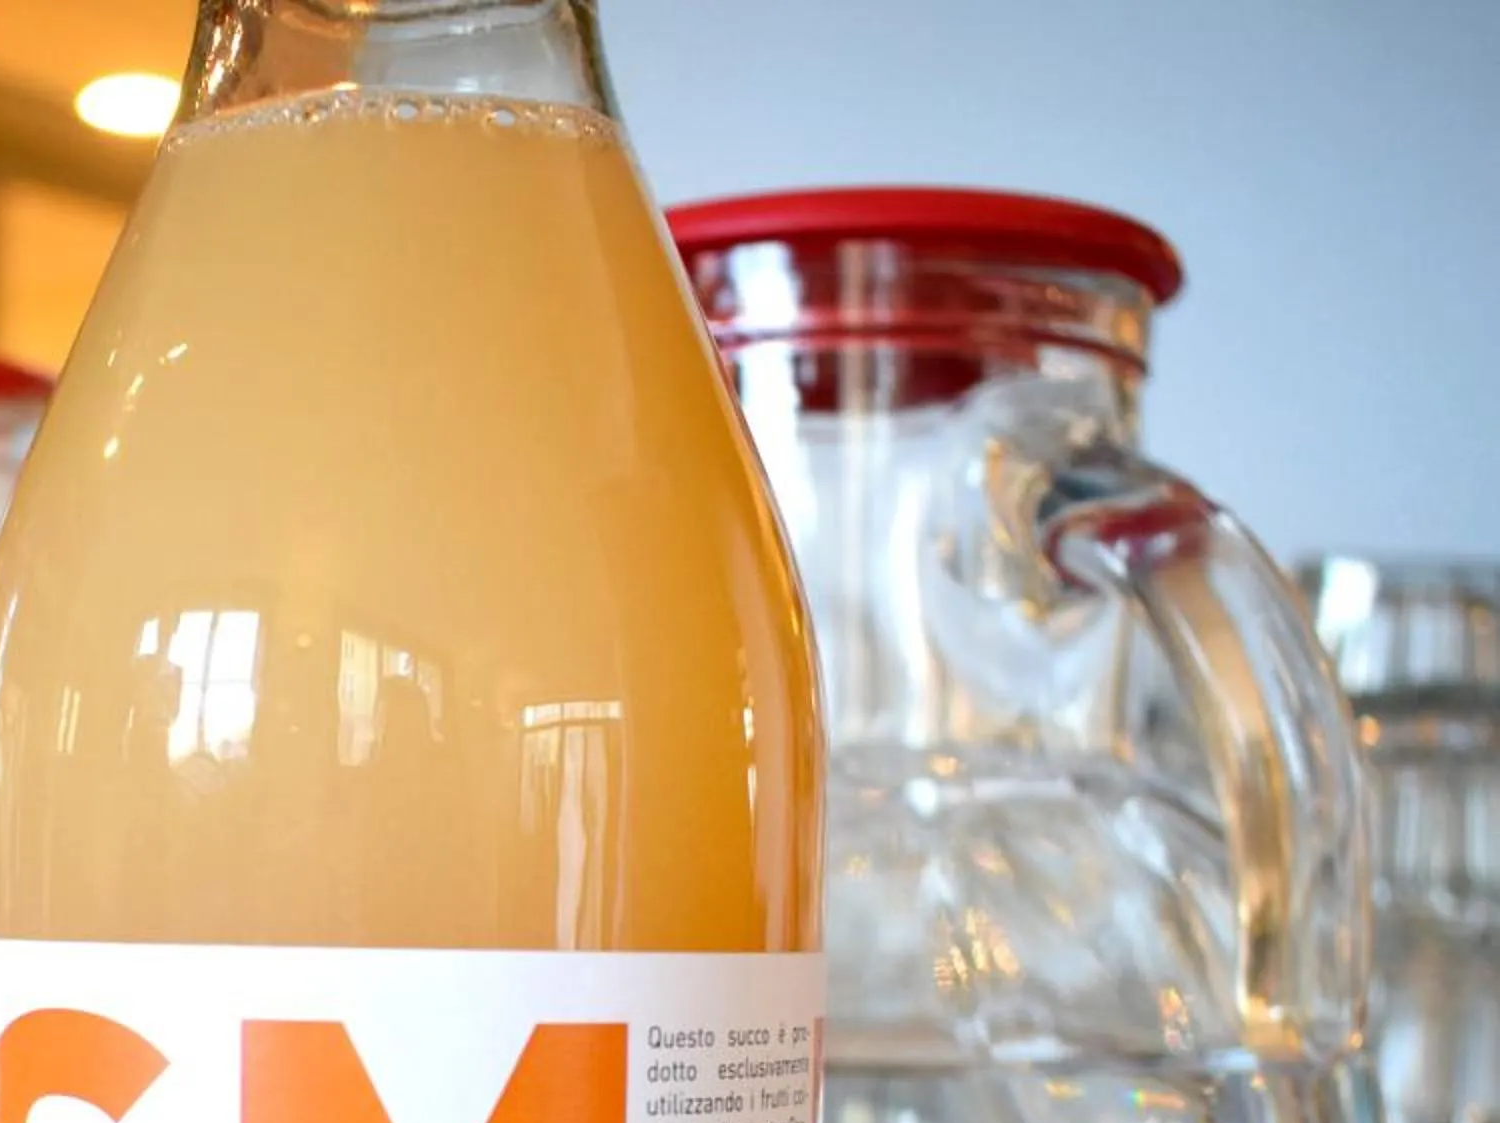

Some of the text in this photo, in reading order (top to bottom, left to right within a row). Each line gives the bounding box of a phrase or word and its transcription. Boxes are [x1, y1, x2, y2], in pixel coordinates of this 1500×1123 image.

[648, 1025, 715, 1048] Questo
[727, 1028, 770, 1047] succo
[647, 1060, 697, 1082] dotto
[646, 1090, 744, 1116] utilizzando
